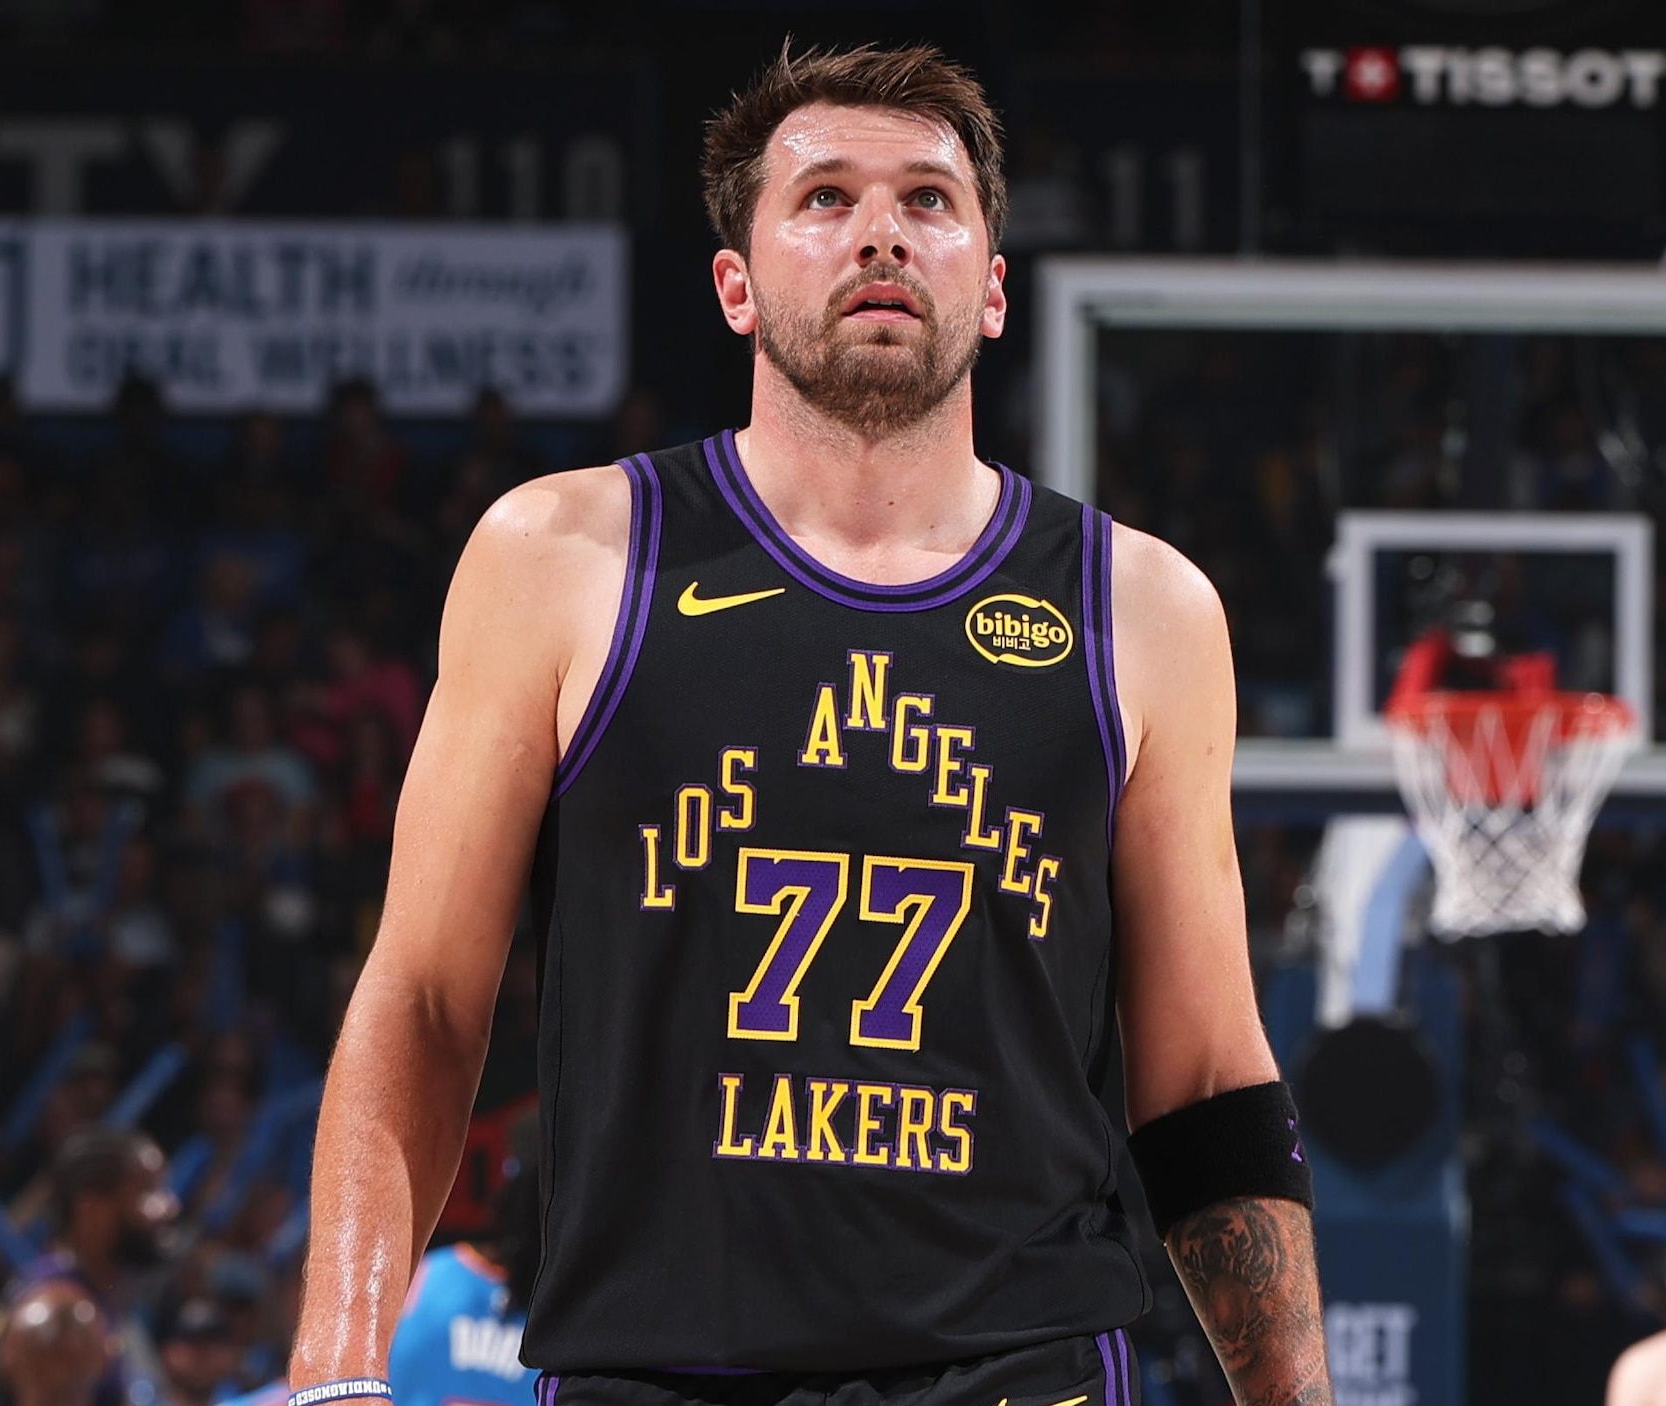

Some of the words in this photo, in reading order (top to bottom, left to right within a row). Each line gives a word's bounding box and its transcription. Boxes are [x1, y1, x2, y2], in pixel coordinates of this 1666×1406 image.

[66, 240, 378, 320] HEALTH
[393, 246, 598, 318] through
[64, 328, 227, 393] ORAL
[975, 611, 1067, 649] bibigo
[992, 636, 1032, 651] 비비고
[639, 745, 759, 912] LOS
[797, 649, 1063, 941] ANGELES
[727, 847, 975, 1053] 77
[712, 1073, 979, 1176] LAKERS
[295, 1380, 382, 1406] UNDIAGNOSED
